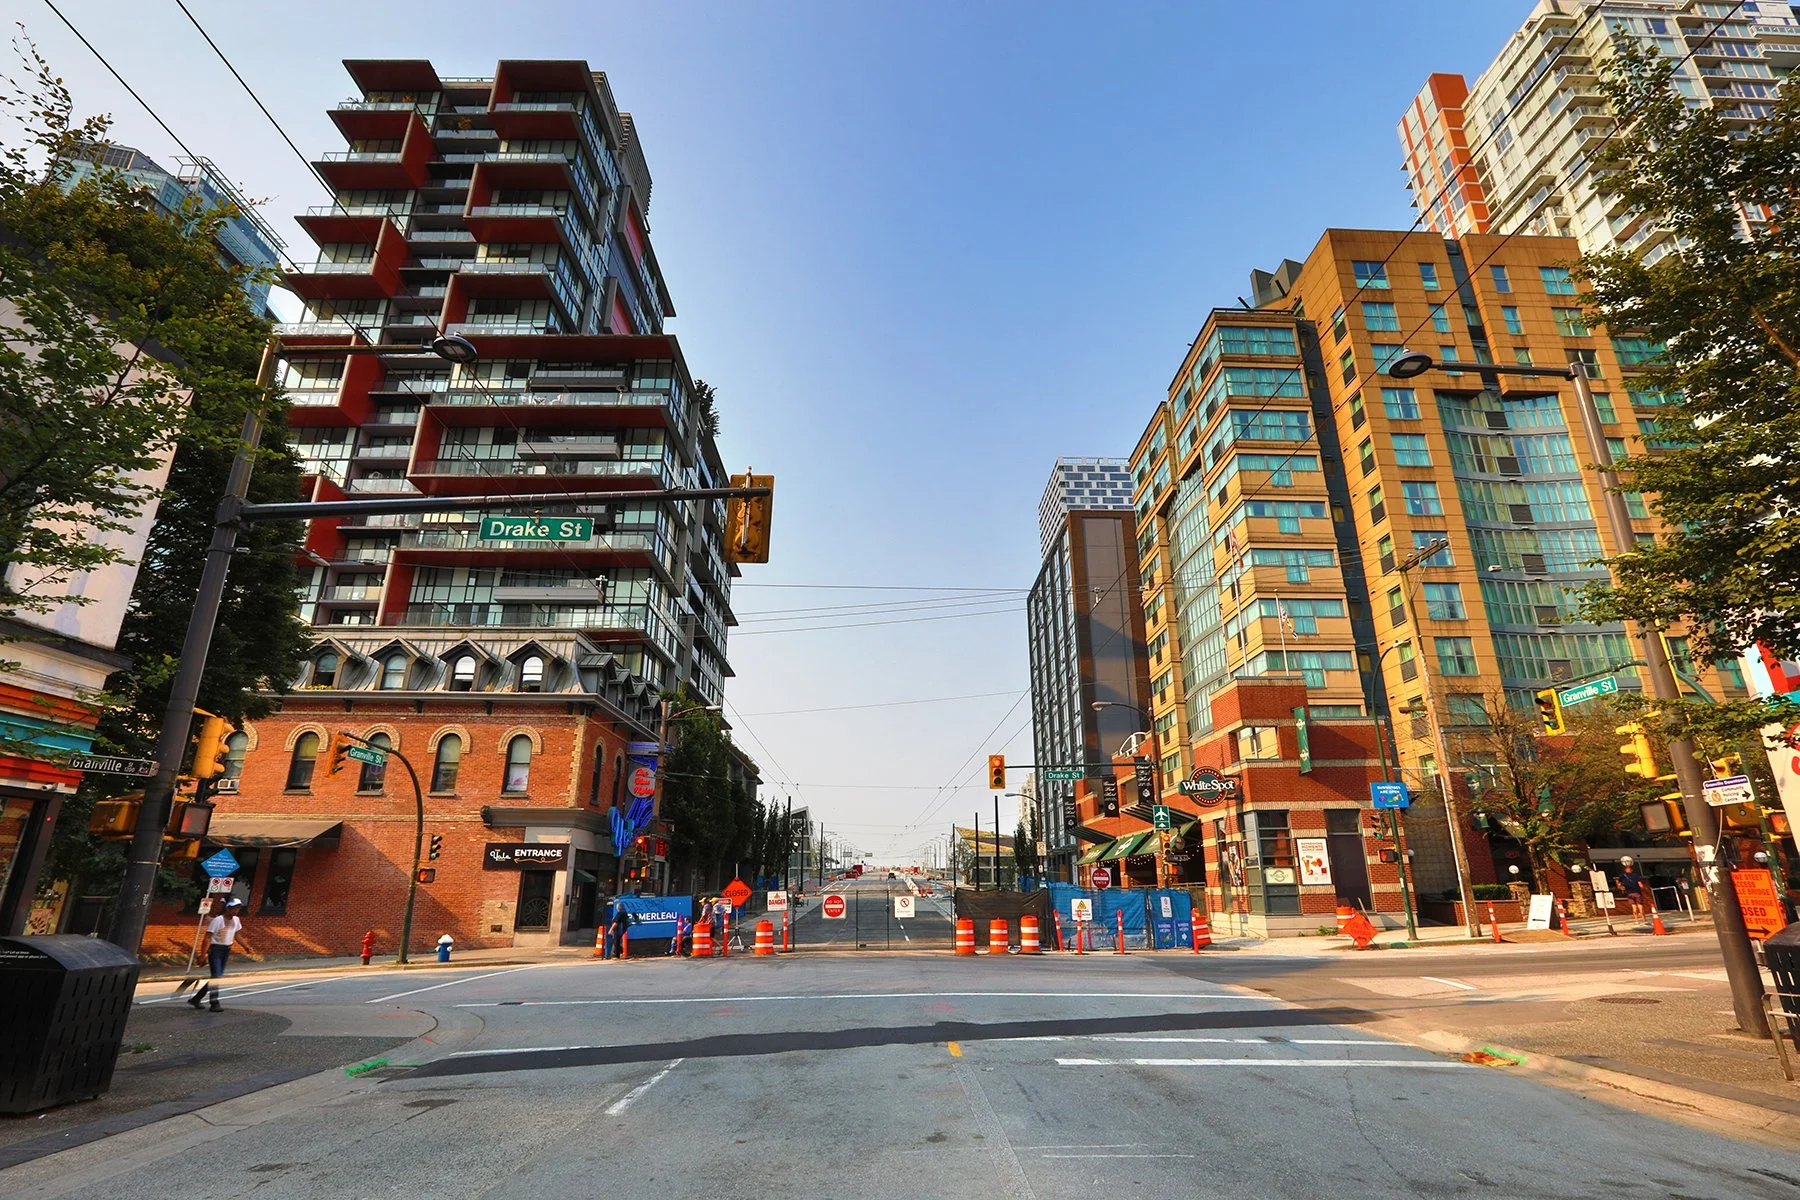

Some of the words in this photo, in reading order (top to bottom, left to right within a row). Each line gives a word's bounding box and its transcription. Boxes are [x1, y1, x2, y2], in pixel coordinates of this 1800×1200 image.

[489, 521, 550, 537] Drake
[559, 521, 582, 537] St
[1563, 686, 1599, 703] Granville
[1601, 680, 1613, 692] St
[350, 748, 374, 762] Granville
[375, 754, 382, 765] St
[73, 759, 122, 772] Granville
[514, 849, 562, 857] ENTRANCE
[725, 889, 749, 897] CLOSED
[627, 911, 678, 921] PMERLEAU
